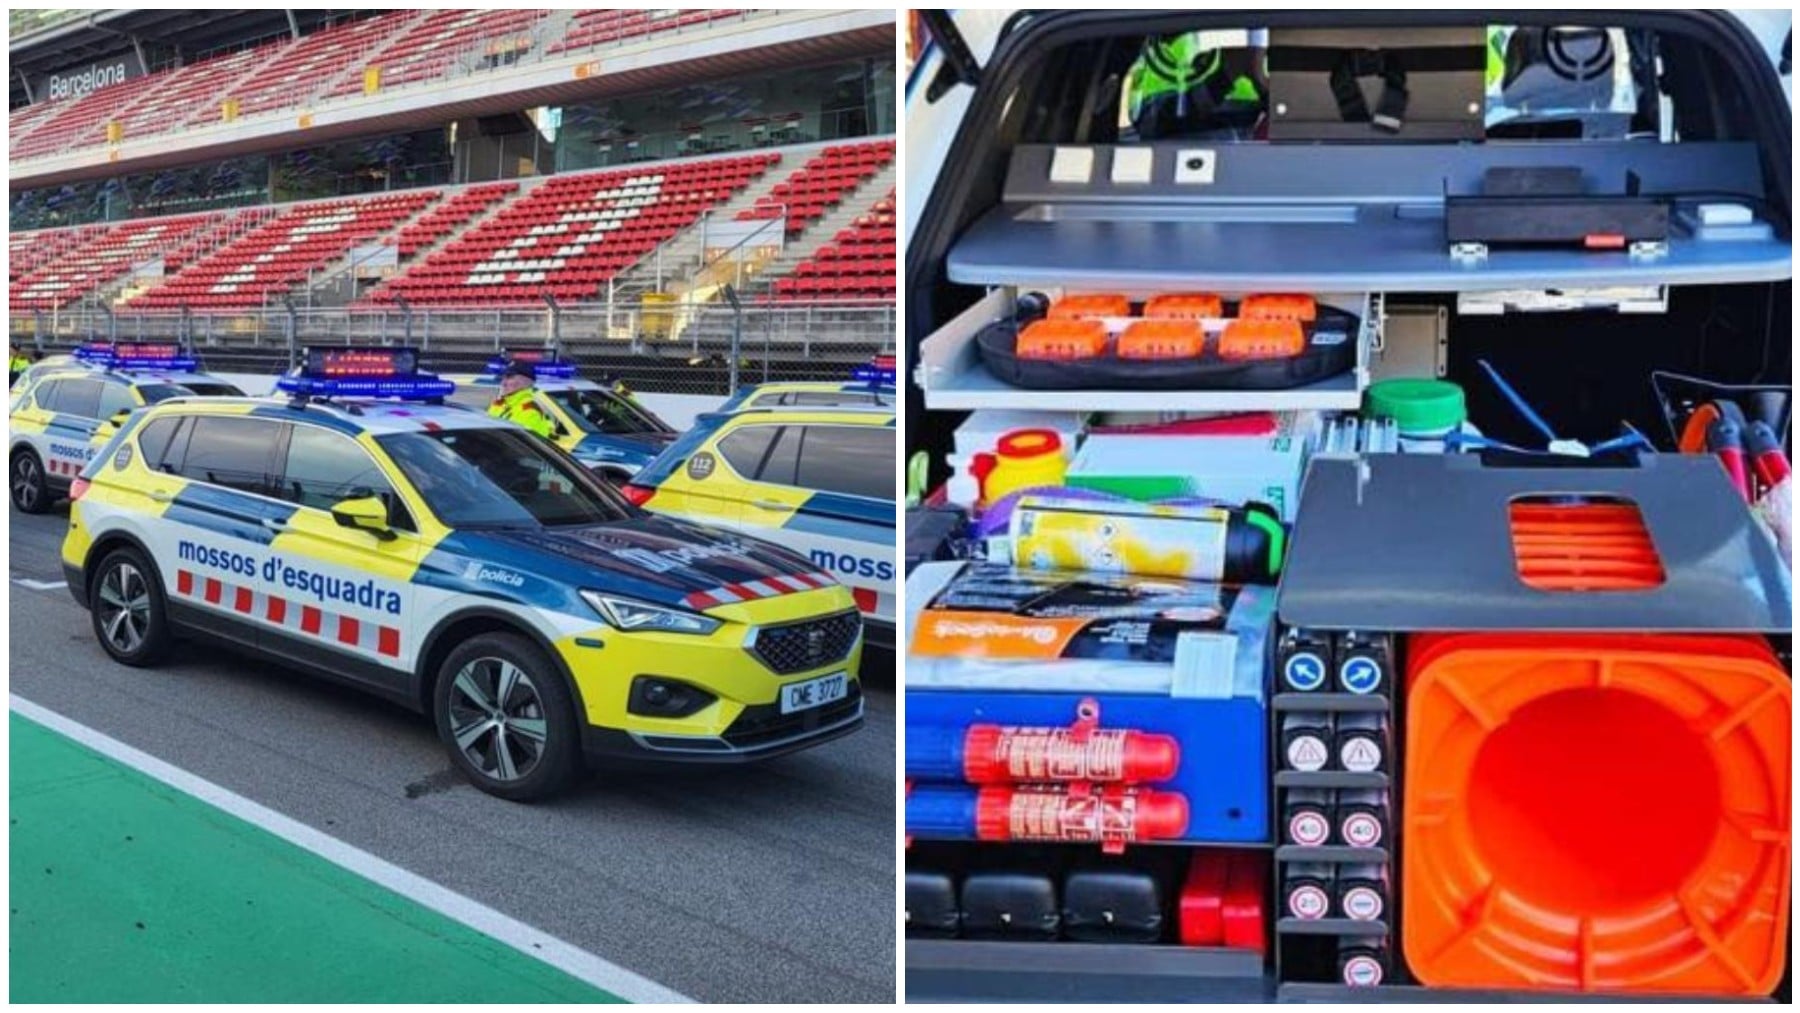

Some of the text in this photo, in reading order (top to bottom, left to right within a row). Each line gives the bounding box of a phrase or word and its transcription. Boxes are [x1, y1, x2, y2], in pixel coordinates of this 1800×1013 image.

[50, 62, 125, 100] Barcelona
[178, 539, 401, 616] mossos d'esquadra
[810, 548, 897, 581] moss
